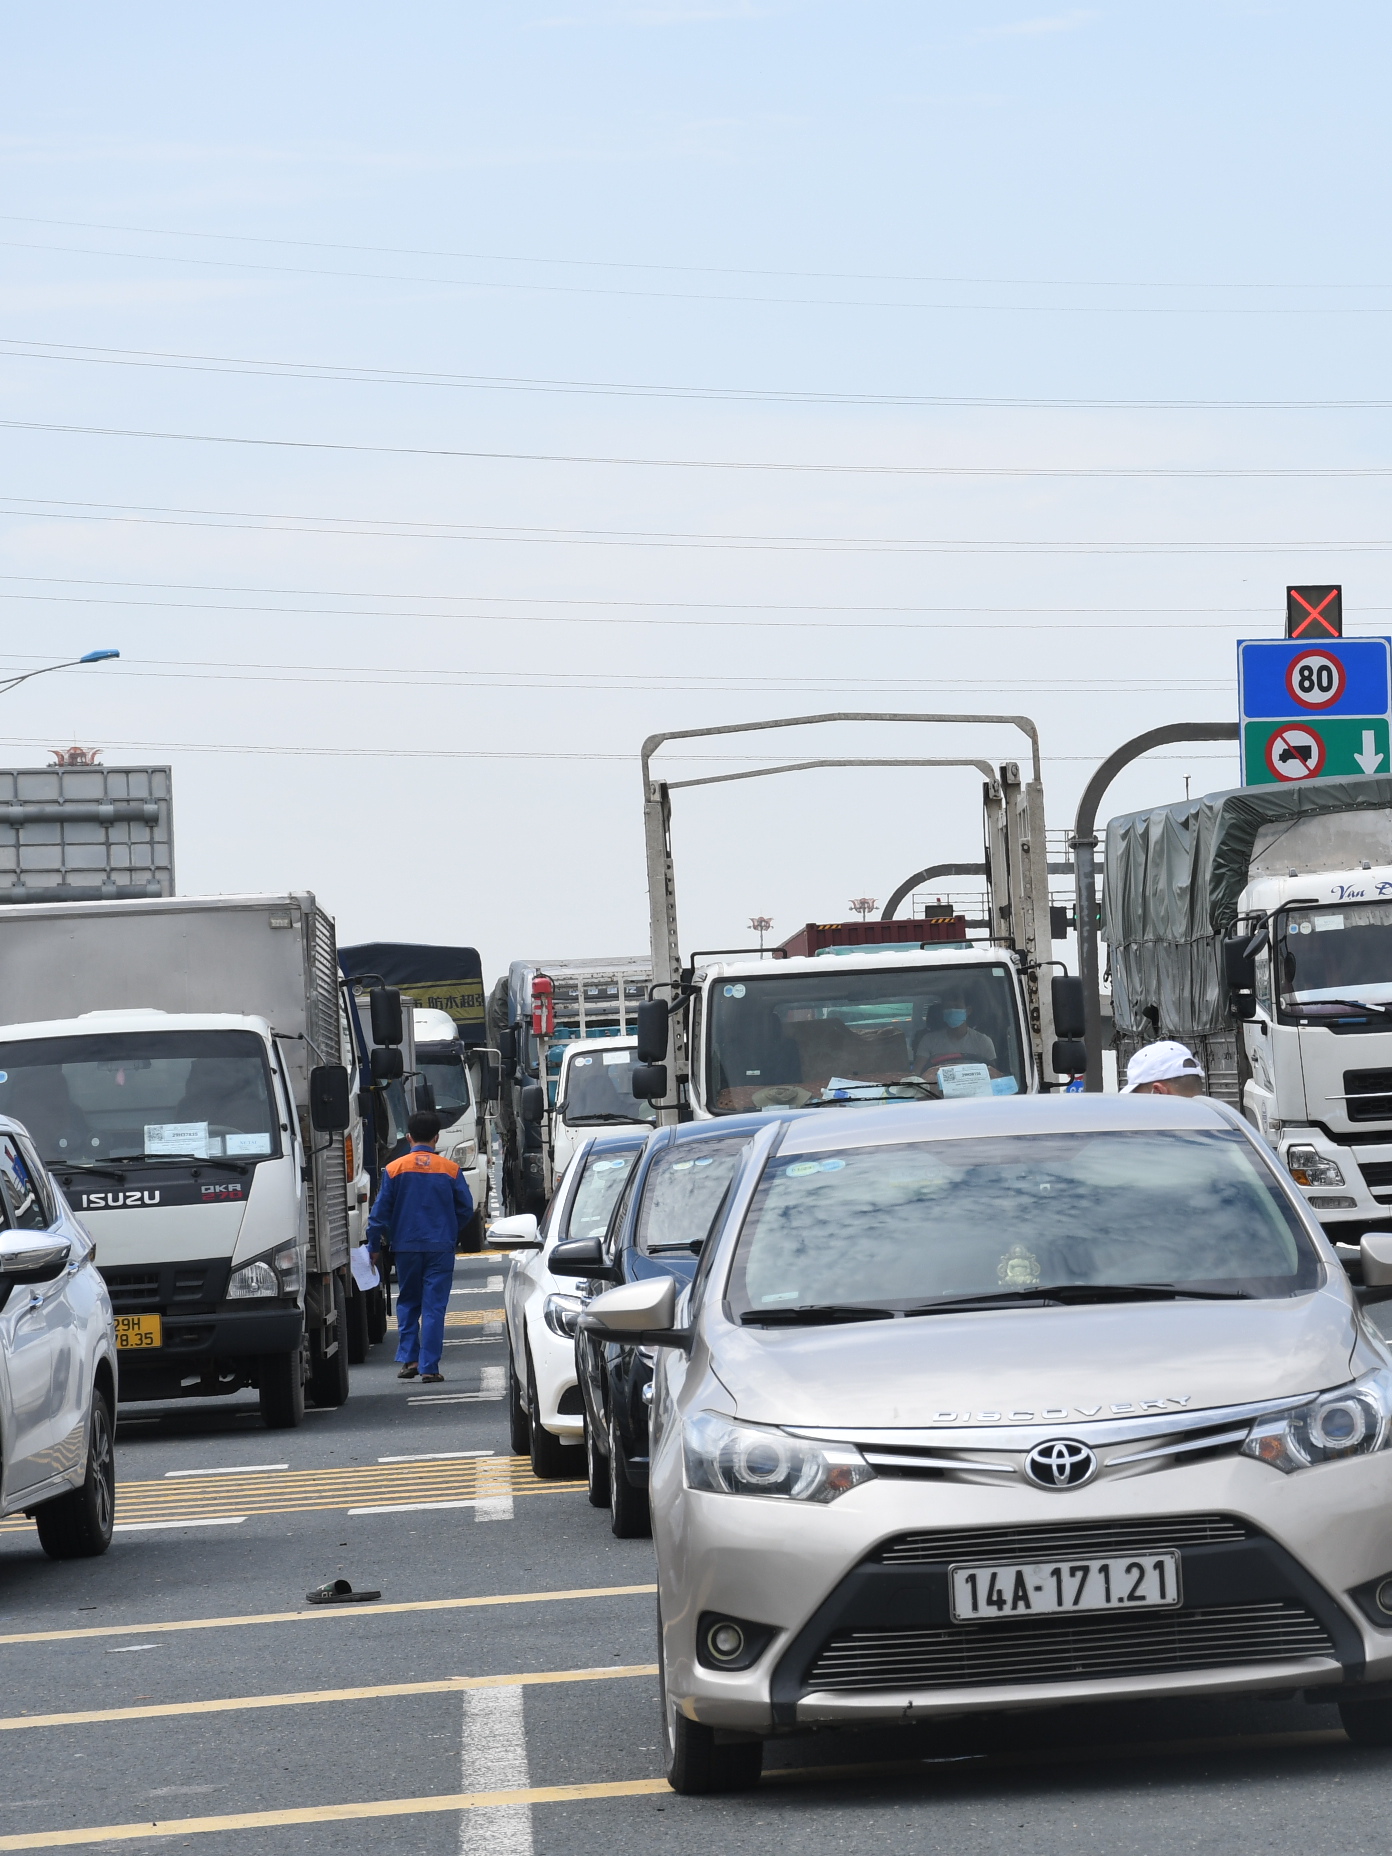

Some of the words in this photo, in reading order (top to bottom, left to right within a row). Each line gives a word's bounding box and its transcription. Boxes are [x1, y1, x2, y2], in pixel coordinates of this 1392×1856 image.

[1298, 664, 1334, 693] 80
[1331, 884, 1366, 900] Vạn
[201, 1184, 242, 1193] QKR
[202, 1192, 243, 1201] 270
[82, 1190, 160, 1208] ISUZU
[932, 1395, 1192, 1422] DISCOVERY
[965, 1559, 1167, 1614] 14A-171.21
